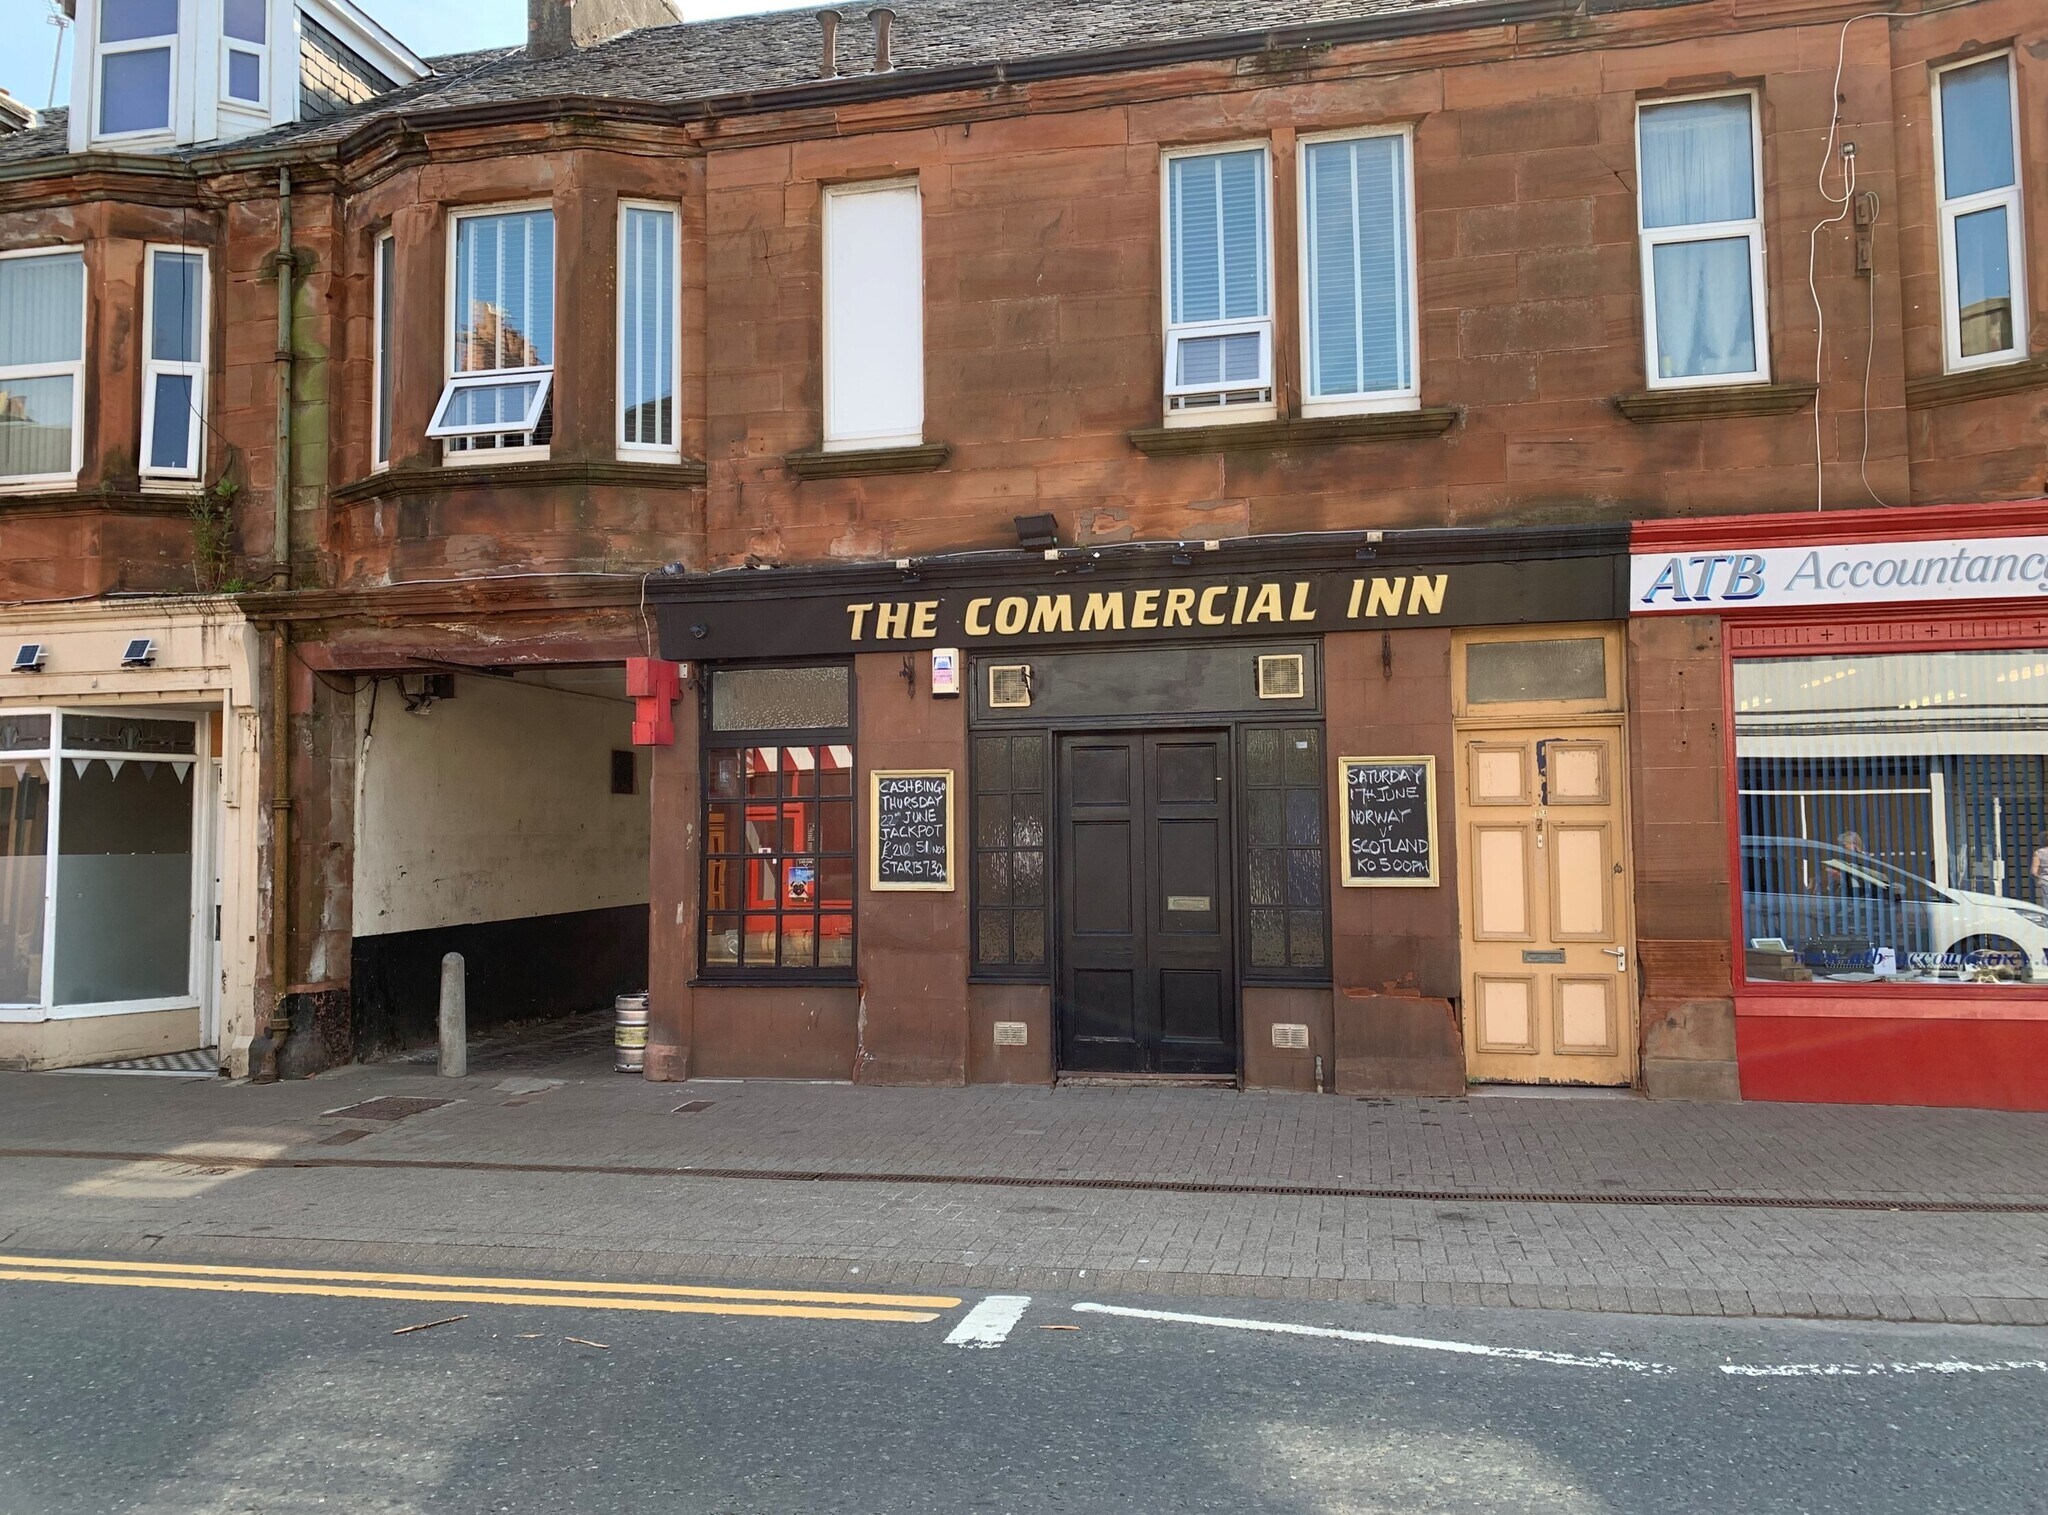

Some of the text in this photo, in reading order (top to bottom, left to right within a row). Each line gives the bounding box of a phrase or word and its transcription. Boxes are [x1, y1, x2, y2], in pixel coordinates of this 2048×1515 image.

[1641, 553, 1766, 604] ATB
[847, 574, 1449, 640] THE COMMERCIAL INN
[1347, 767, 1423, 786] SATURDAY
[1376, 786, 1419, 802] JUNE
[881, 795, 943, 811] THURSDAY
[902, 809, 937, 824] JUNE
[1351, 808, 1412, 827] NORWAY
[880, 824, 943, 840] JACKPOT
[916, 841, 929, 853] 51
[1351, 838, 1429, 854] SCOTLAND
[881, 860, 923, 876] STARTS
[1358, 858, 1377, 873] KO
